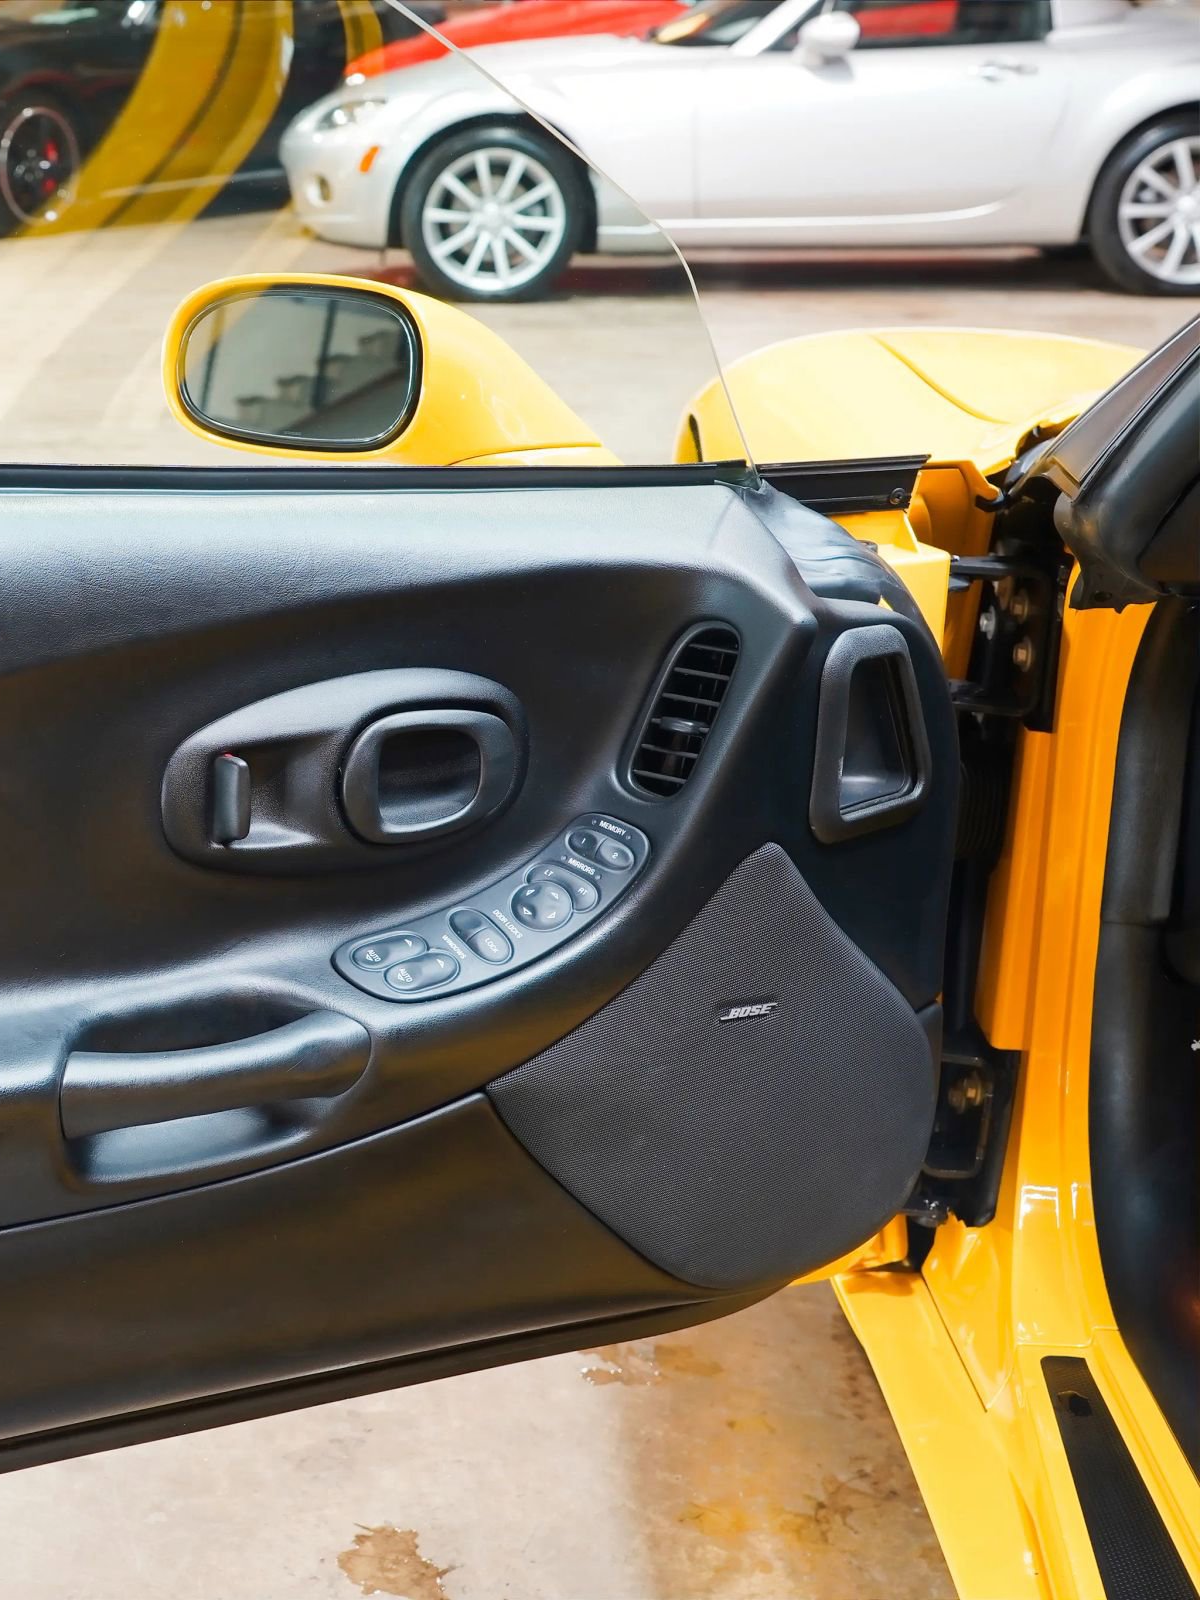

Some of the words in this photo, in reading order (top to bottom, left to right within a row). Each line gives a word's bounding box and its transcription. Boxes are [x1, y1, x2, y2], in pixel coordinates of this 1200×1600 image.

[598, 820, 627, 837] MEMORY
[611, 852, 619, 860] 2
[543, 869, 554, 877] LT
[567, 857, 596, 876] MIRRORS
[577, 886, 588, 896] RT
[492, 908, 508, 924] DOOR
[504, 919, 524, 939] LOCKS
[441, 934, 467, 960] WINDOWS
[484, 937, 500, 954] LOCK
[367, 949, 382, 963] AUTO
[399, 967, 413, 983] AUTO
[720, 1002, 778, 1021] BOSE
